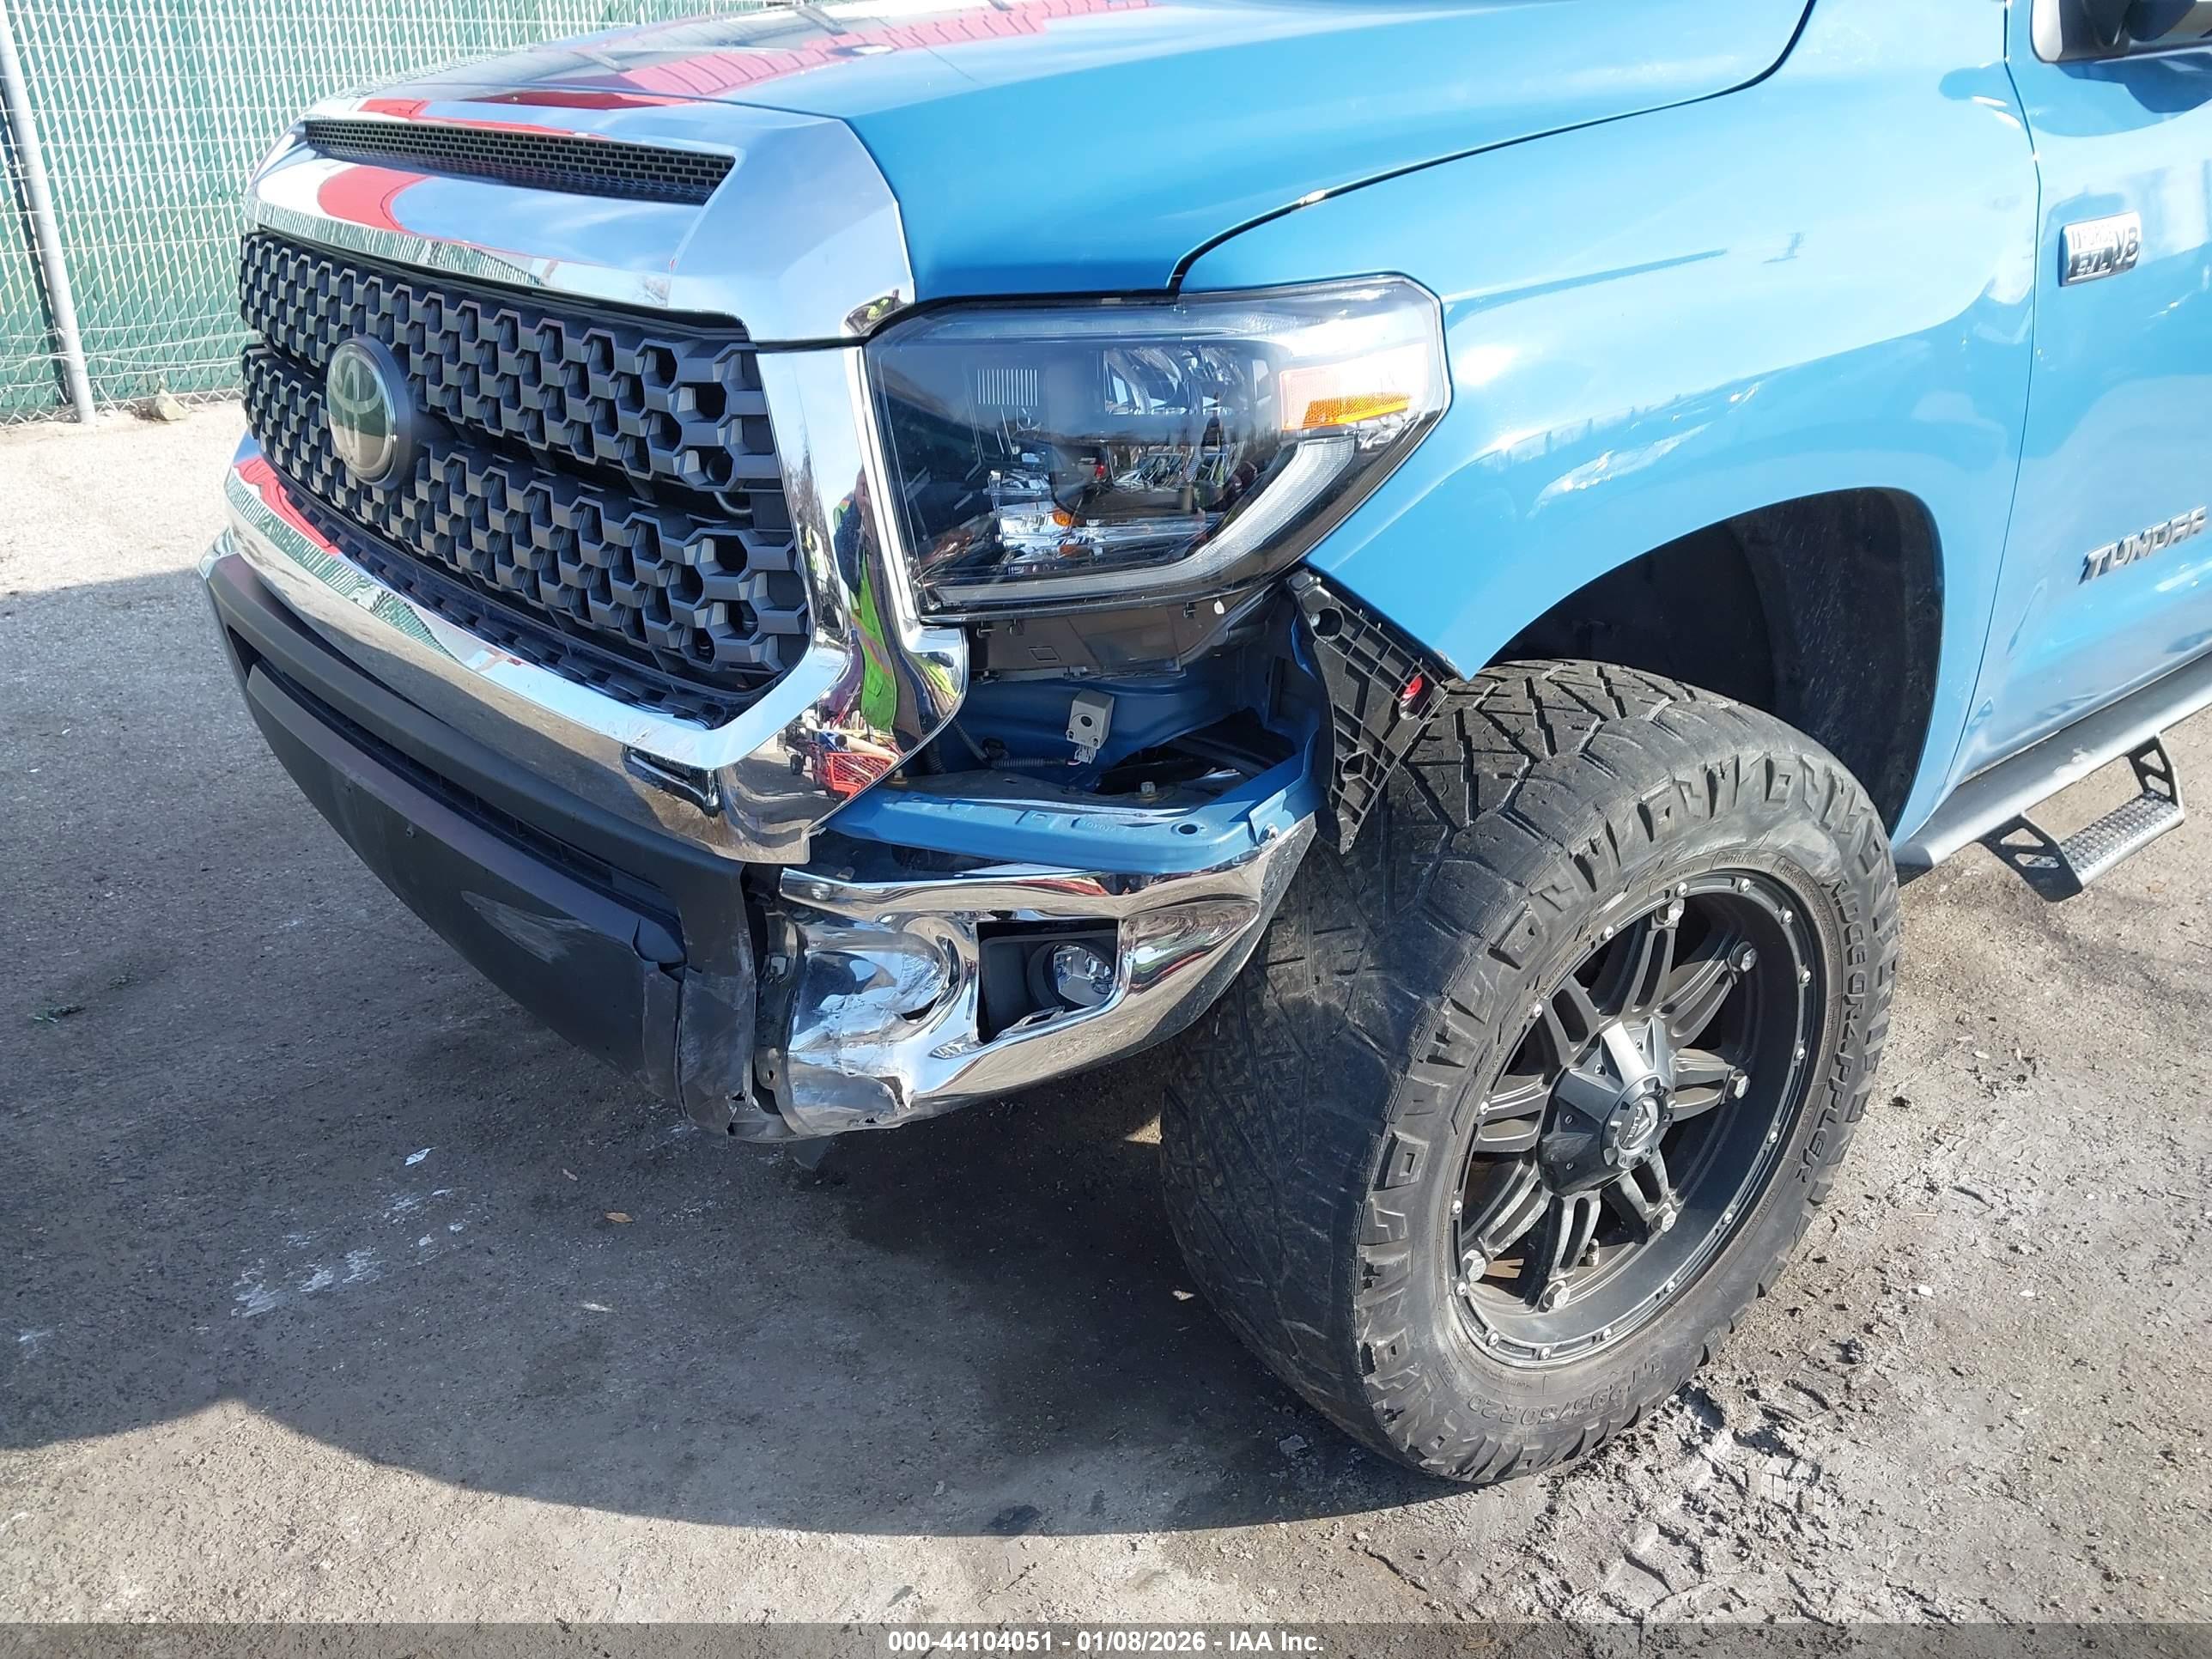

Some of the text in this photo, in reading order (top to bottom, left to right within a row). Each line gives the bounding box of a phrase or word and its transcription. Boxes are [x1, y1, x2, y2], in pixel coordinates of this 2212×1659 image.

[2114, 226, 2139, 267] V8
[2078, 506, 2208, 586] TUNDRA
[1795, 972, 1867, 1184] GRAPPLER
[1621, 1105, 1644, 1145] FUEL
